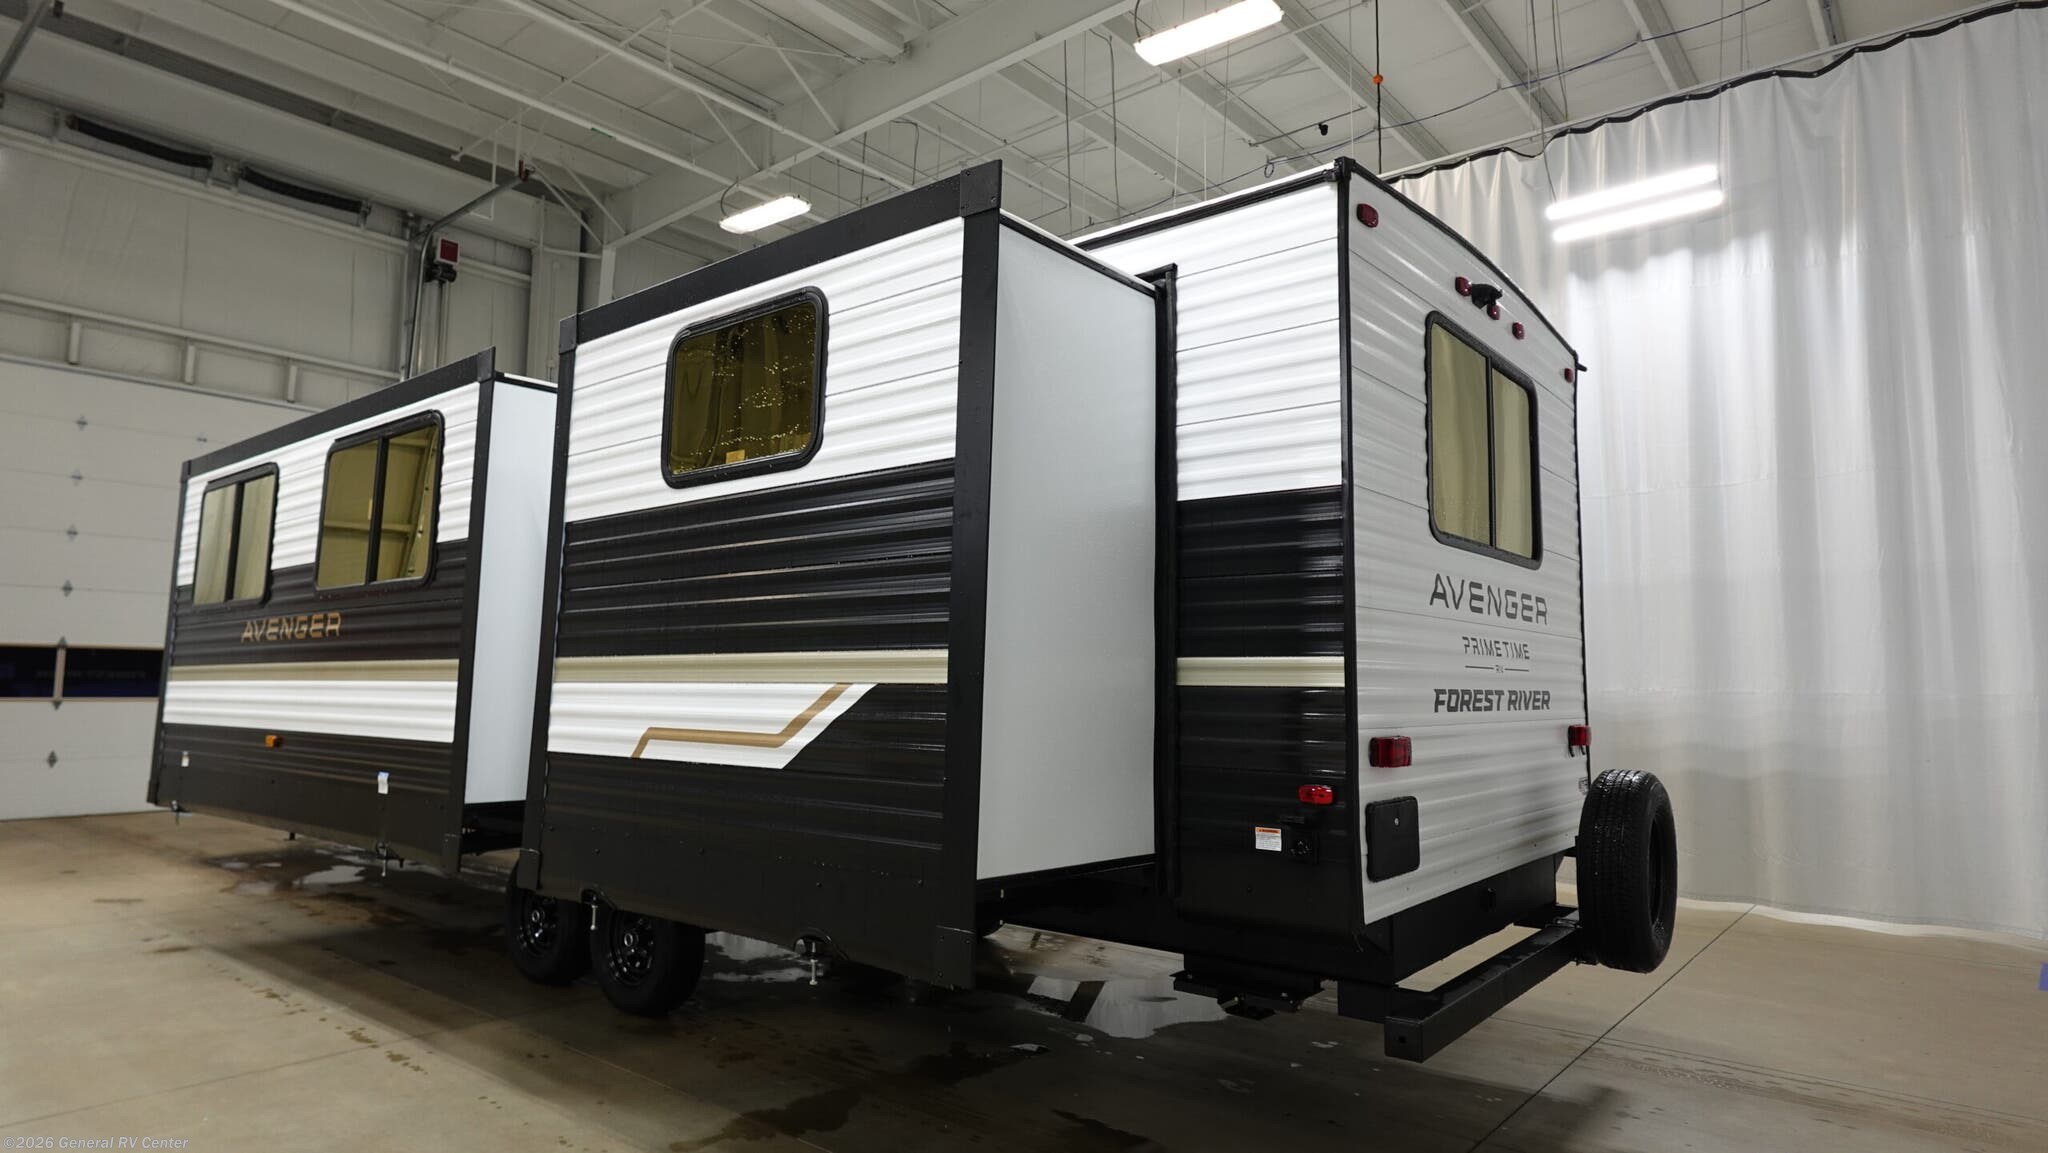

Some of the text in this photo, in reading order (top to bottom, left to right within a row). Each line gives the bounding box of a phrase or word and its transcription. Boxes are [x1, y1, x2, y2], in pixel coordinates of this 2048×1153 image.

[1429, 573, 1548, 625] AVENGER
[241, 612, 341, 644] AVENGER
[1434, 688, 1551, 713] FOREST RIVER
